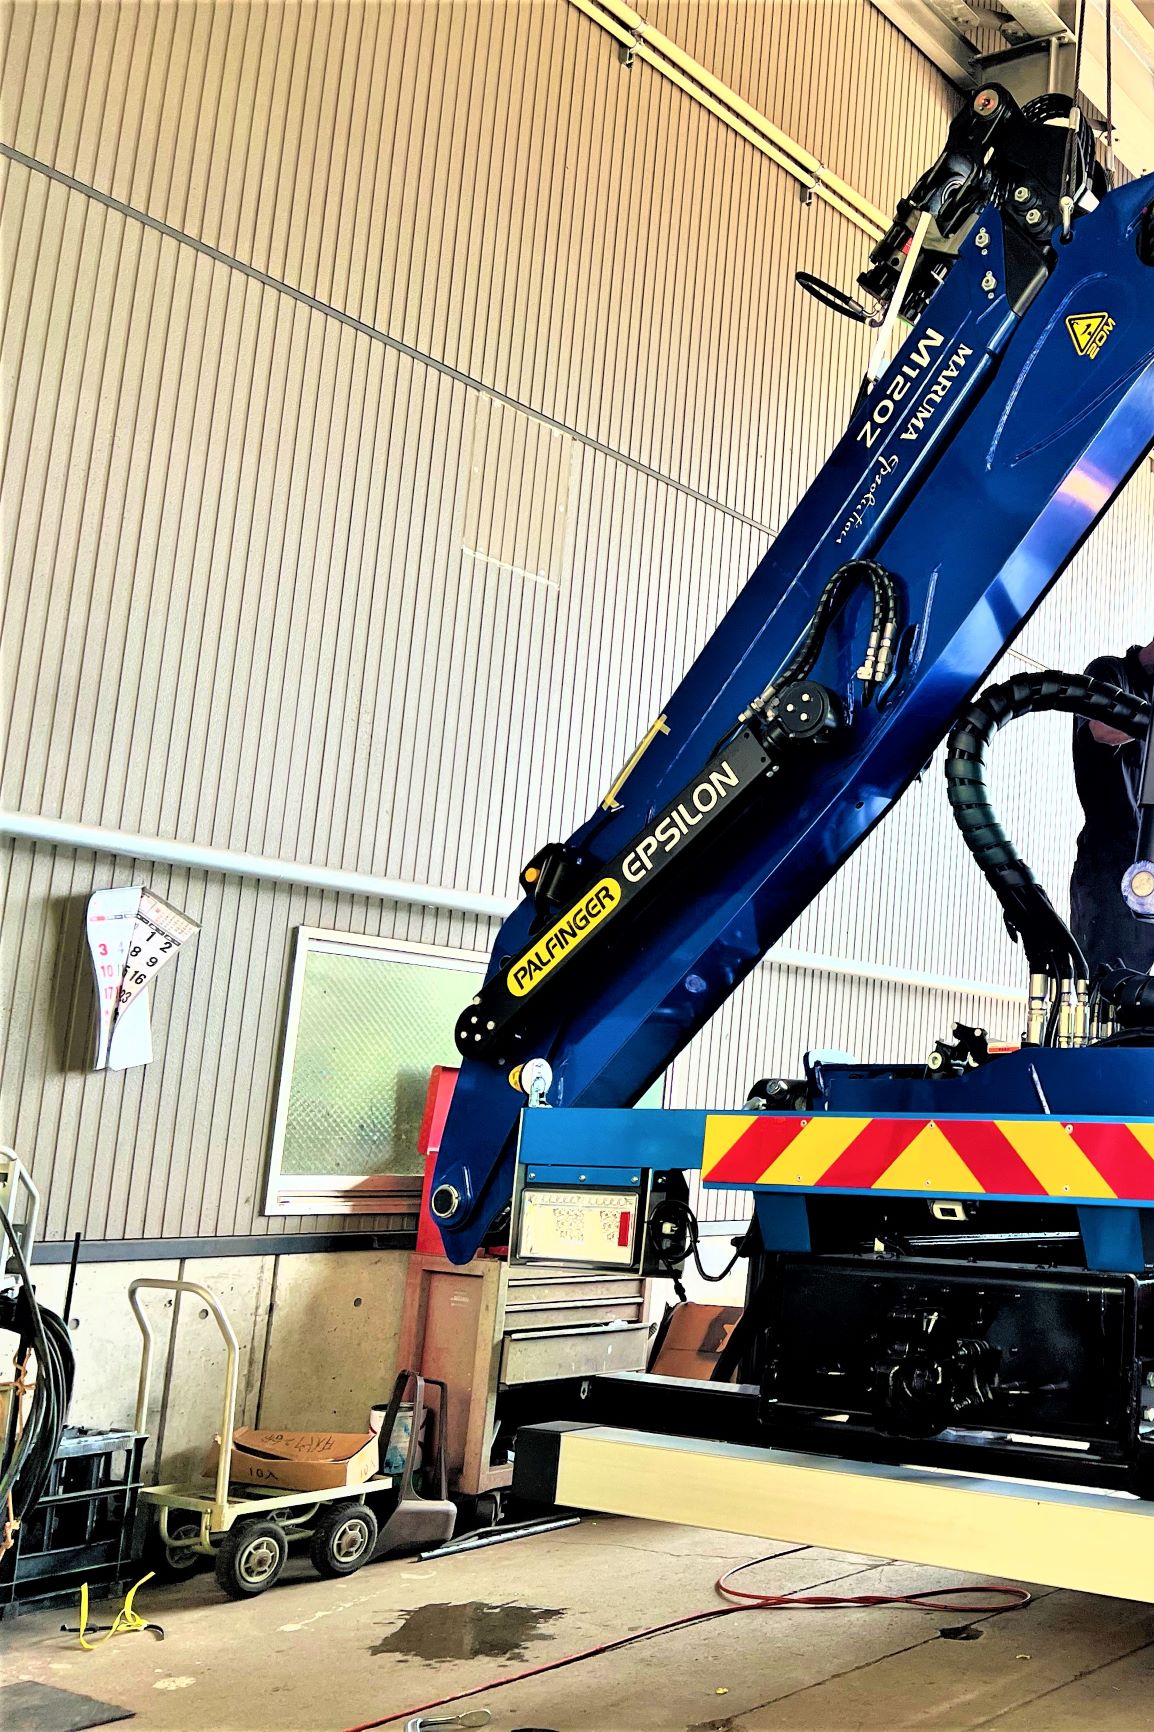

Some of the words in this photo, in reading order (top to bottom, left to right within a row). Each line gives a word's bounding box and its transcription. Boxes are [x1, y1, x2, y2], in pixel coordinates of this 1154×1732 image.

[1086, 317, 1116, 360] 20M
[856, 327, 945, 449] M120Z
[900, 342, 974, 441] MARUMA
[512, 885, 616, 991] PALFINGER
[621, 760, 740, 883] EPSILON
[98, 943, 108, 956] 3
[130, 946, 142, 957] 8
[146, 956, 158, 967] 9
[159, 941, 173, 953] 2
[129, 970, 147, 985] 16
